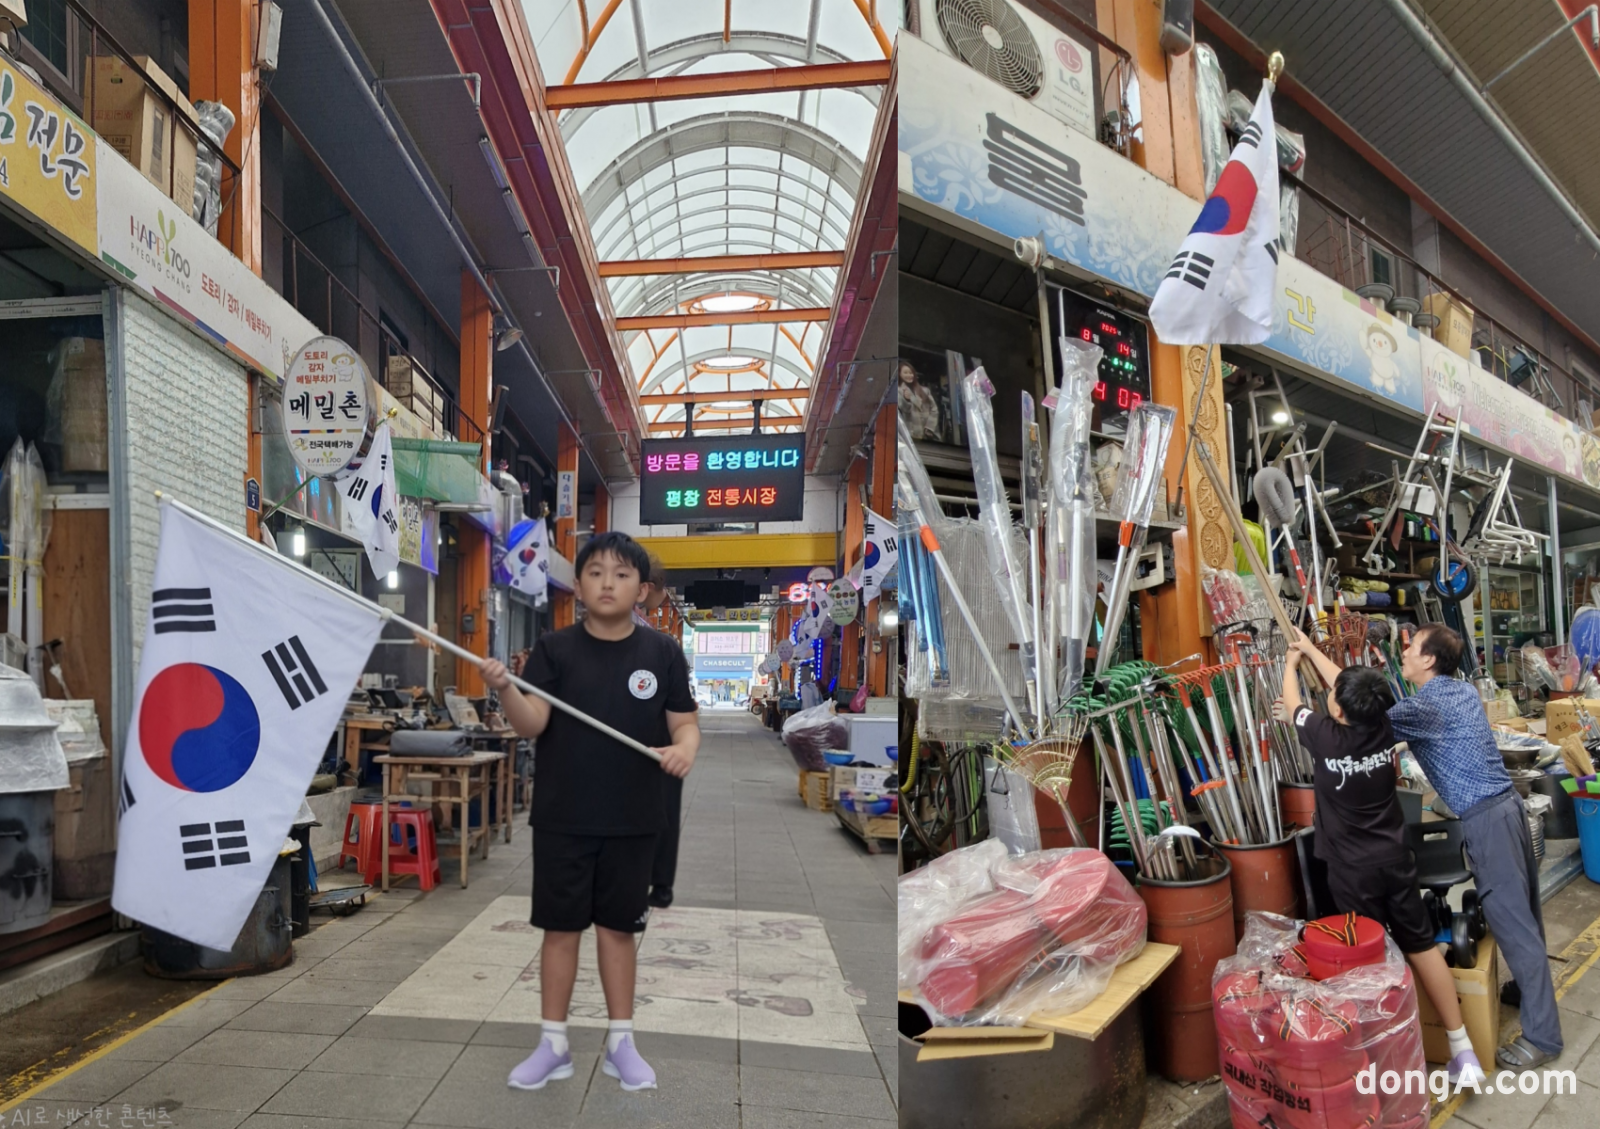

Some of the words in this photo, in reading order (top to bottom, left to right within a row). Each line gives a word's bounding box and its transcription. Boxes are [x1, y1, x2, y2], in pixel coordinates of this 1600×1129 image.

[1059, 68, 1081, 93] LG
[25, 103, 89, 197] 전문
[130, 242, 162, 272] PYEONG
[165, 269, 191, 294] CHANG
[201, 272, 221, 305] 도토리
[227, 292, 240, 319] 감자
[245, 308, 272, 344] 메밀부치기
[1284, 287, 1317, 335] 간
[1083, 329, 1090, 341] 8
[1101, 322, 1117, 335] 2025
[304, 351, 328, 361] 도토리
[1119, 343, 1130, 356] 14
[308, 363, 325, 373] 감자
[296, 374, 337, 385] 메밀부치기
[289, 390, 362, 421] 메밀촌
[309, 440, 354, 450] 전국택배가능
[646, 452, 700, 473] 방문을
[706, 448, 800, 470] 환영합니다
[251, 494, 256, 506] 5
[665, 489, 700, 508] 평창
[706, 486, 777, 507] 전통시장
[1224, 1061, 1256, 1091] 국내산
